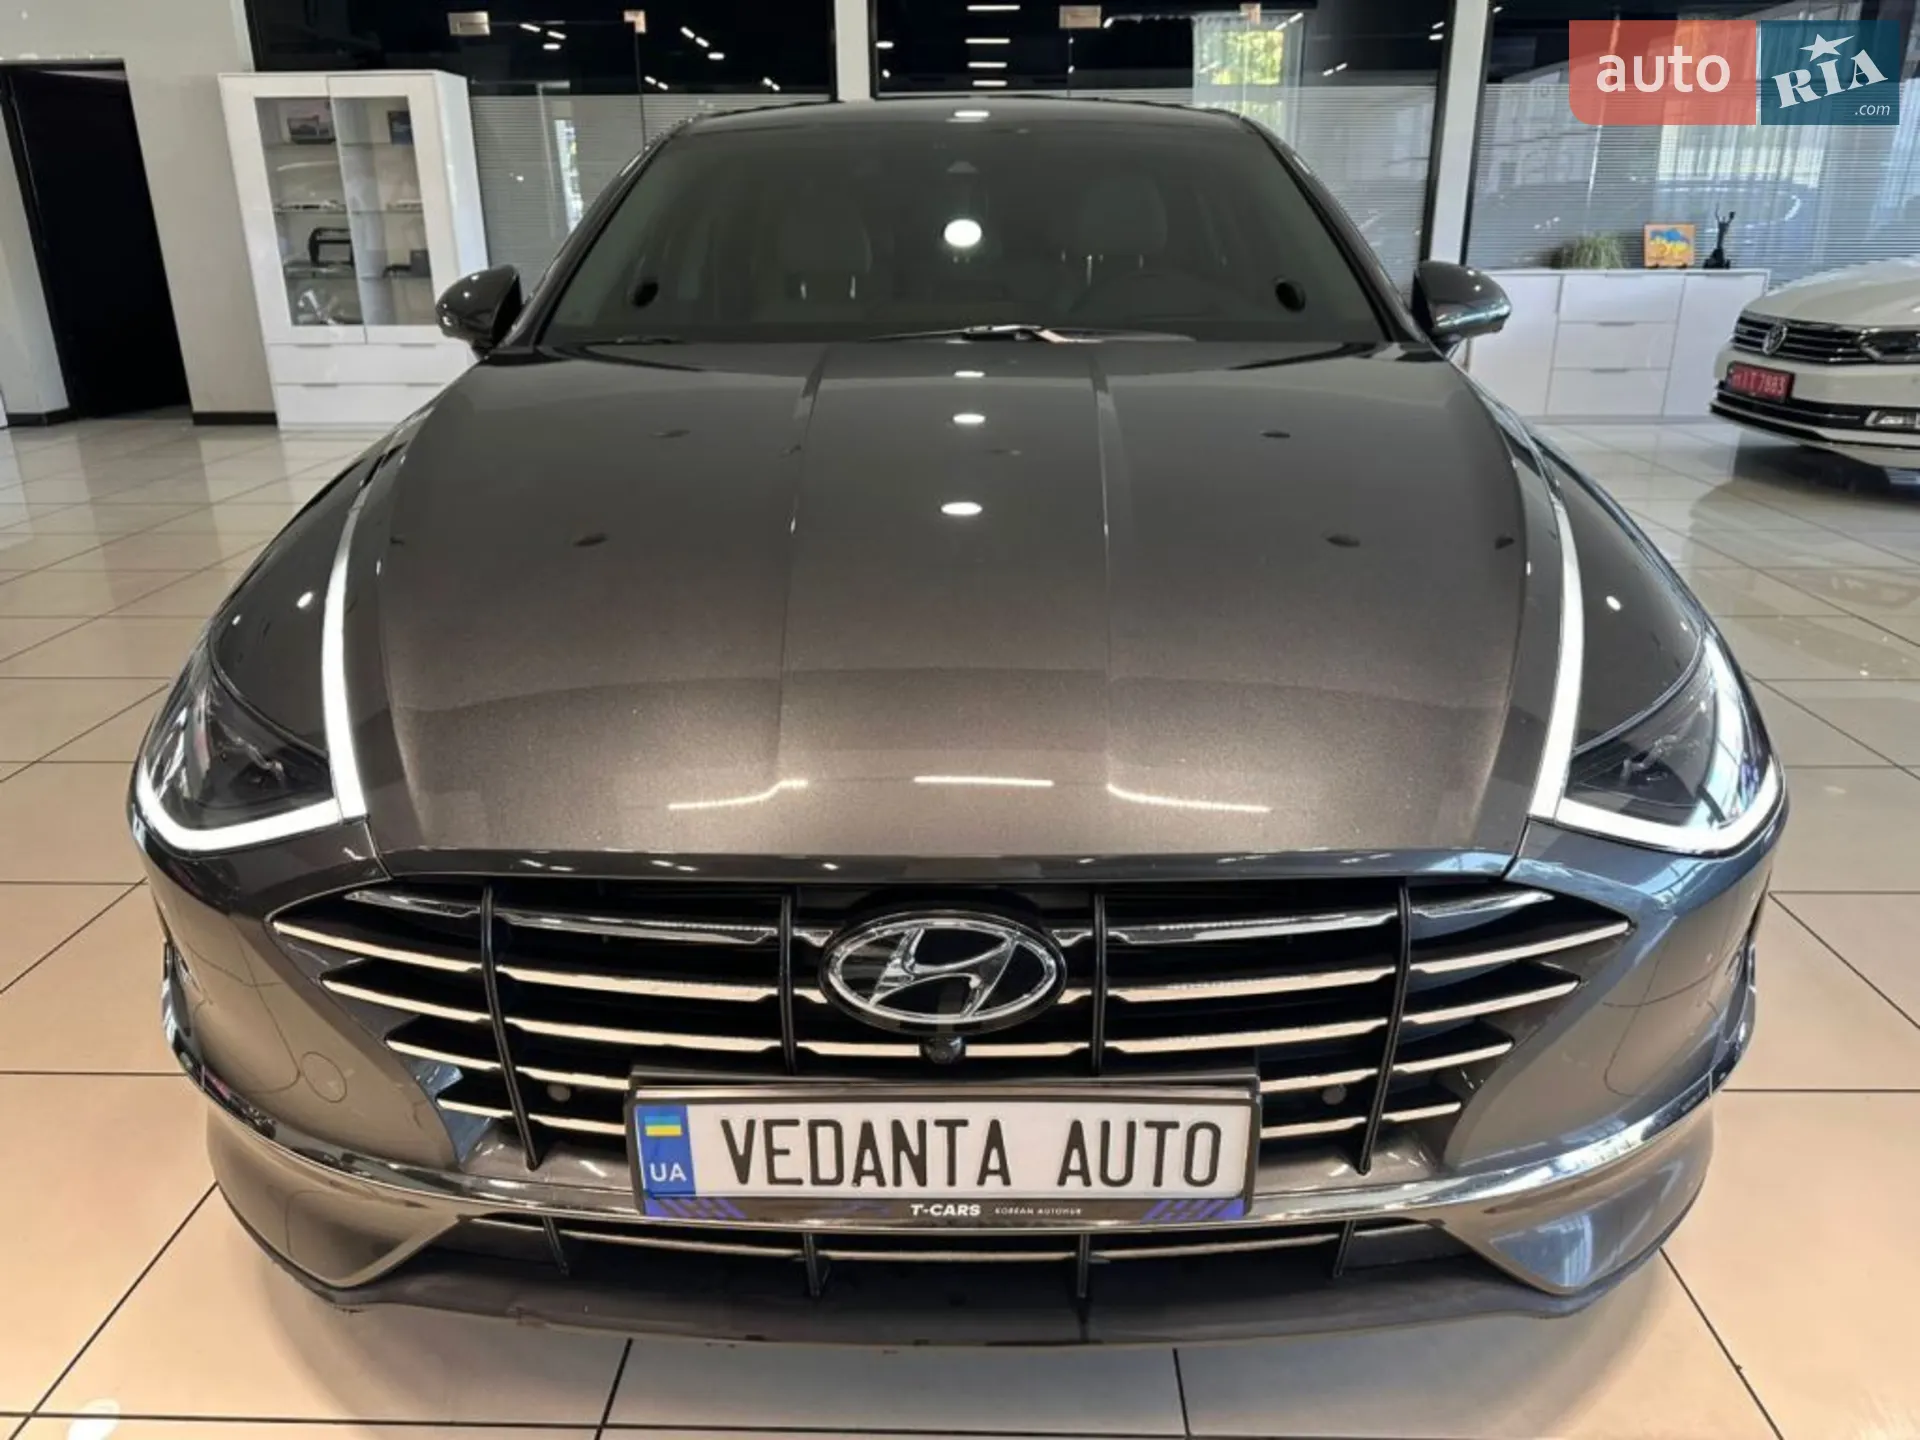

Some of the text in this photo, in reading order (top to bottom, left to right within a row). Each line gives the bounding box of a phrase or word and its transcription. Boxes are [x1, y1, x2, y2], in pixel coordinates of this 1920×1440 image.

[721, 1118, 1223, 1187] VEDANTA AUTO
[649, 1162, 688, 1182] UA
[911, 1204, 981, 1217] T-CARS
[995, 1207, 1034, 1215] KOREAN
